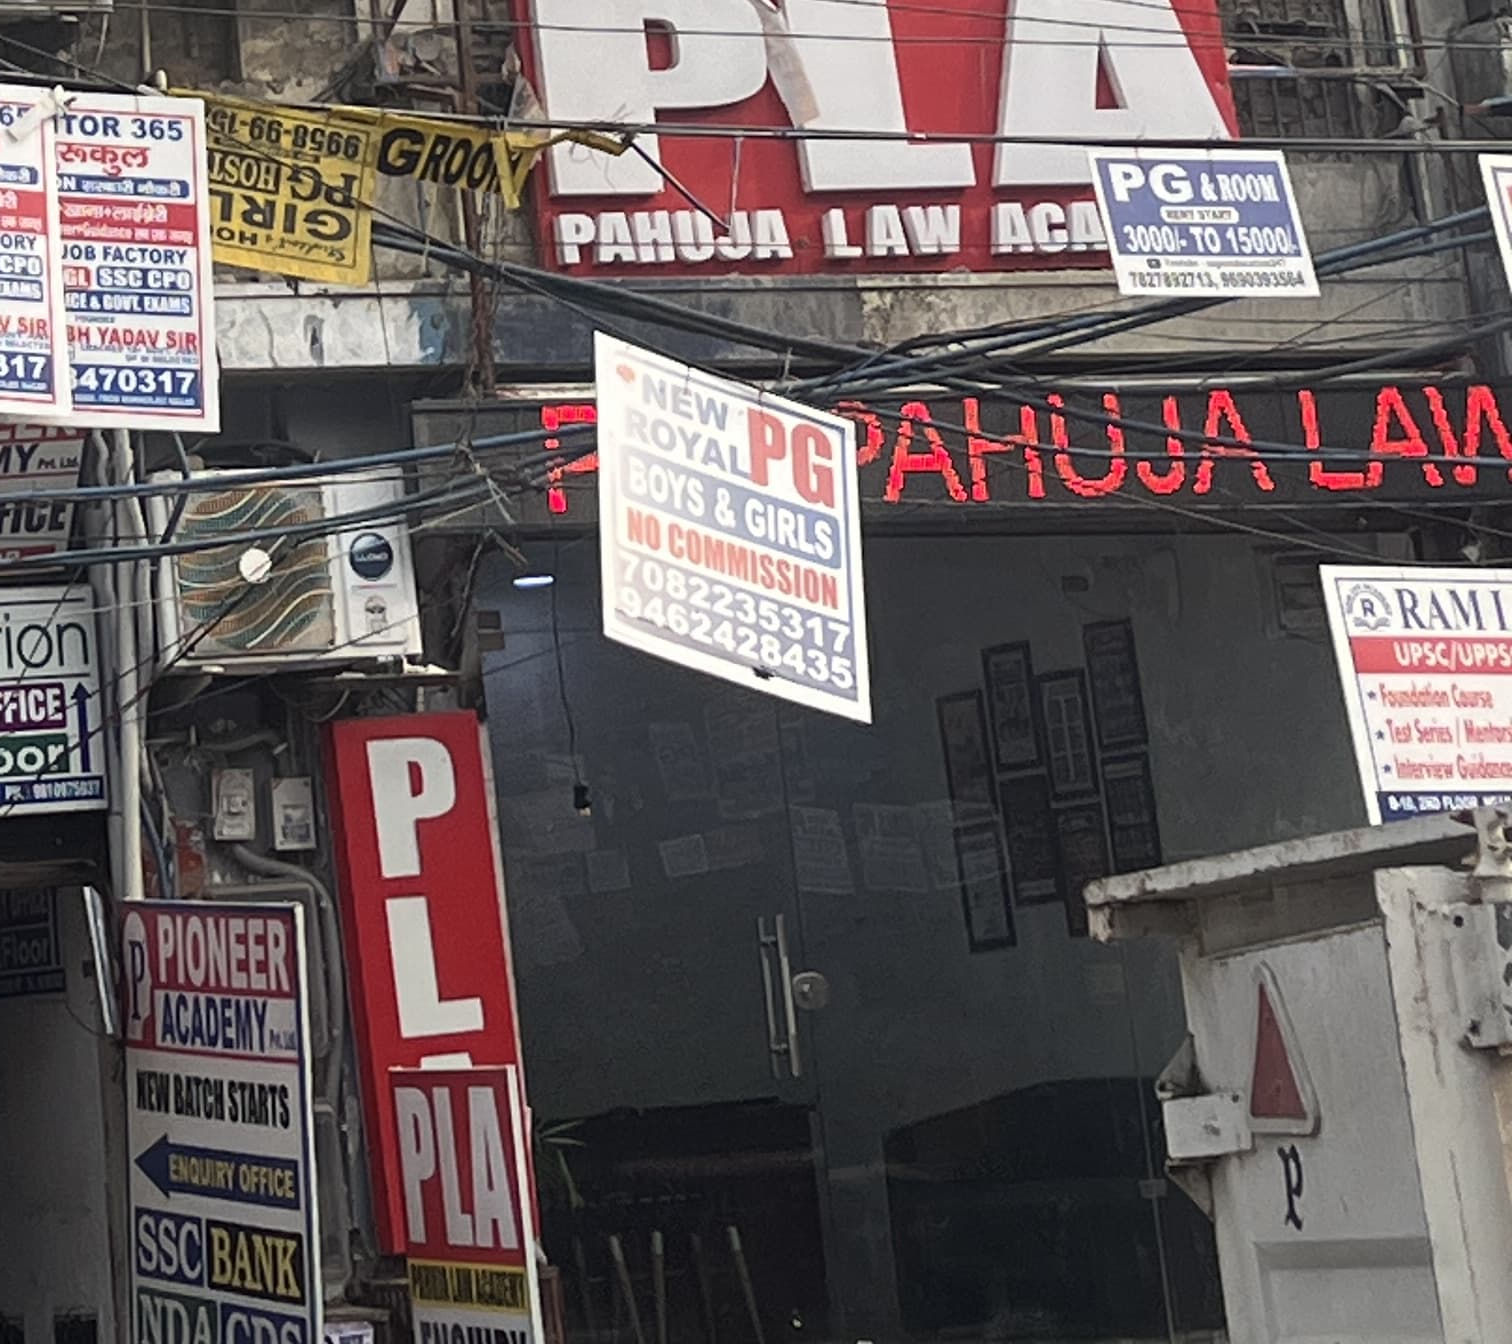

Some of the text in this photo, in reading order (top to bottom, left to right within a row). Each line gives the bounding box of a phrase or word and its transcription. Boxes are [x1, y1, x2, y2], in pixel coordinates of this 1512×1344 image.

[288, 164, 358, 210] PG
[1108, 163, 1280, 203] PG & ROOM
[555, 204, 962, 266] PAHUJA LAW
[1123, 225, 1187, 253] 3000/-
[1190, 226, 1222, 254] TO
[642, 373, 729, 431] NEW
[625, 406, 752, 479] ROYAL
[747, 407, 836, 509] PG
[628, 456, 834, 560] BOYS & GIRLS
[627, 507, 839, 610] NO COMMISSION
[619, 555, 852, 654] 7082235317
[1395, 588, 1486, 631] RAM
[620, 587, 854, 690] 9462428435
[1380, 683, 1494, 709] Foundation Course
[1386, 719, 1453, 744] Test Series
[157, 913, 291, 991] PIONEER
[160, 991, 268, 1054] ACADEMY
[136, 1068, 289, 1129] NEW BATCH STARTS
[168, 1152, 295, 1200] ENQUIRY OFFICE
[393, 1084, 519, 1251] PLA
[1277, 1144, 1304, 1233] P
[137, 1215, 301, 1301] SSC BANK
